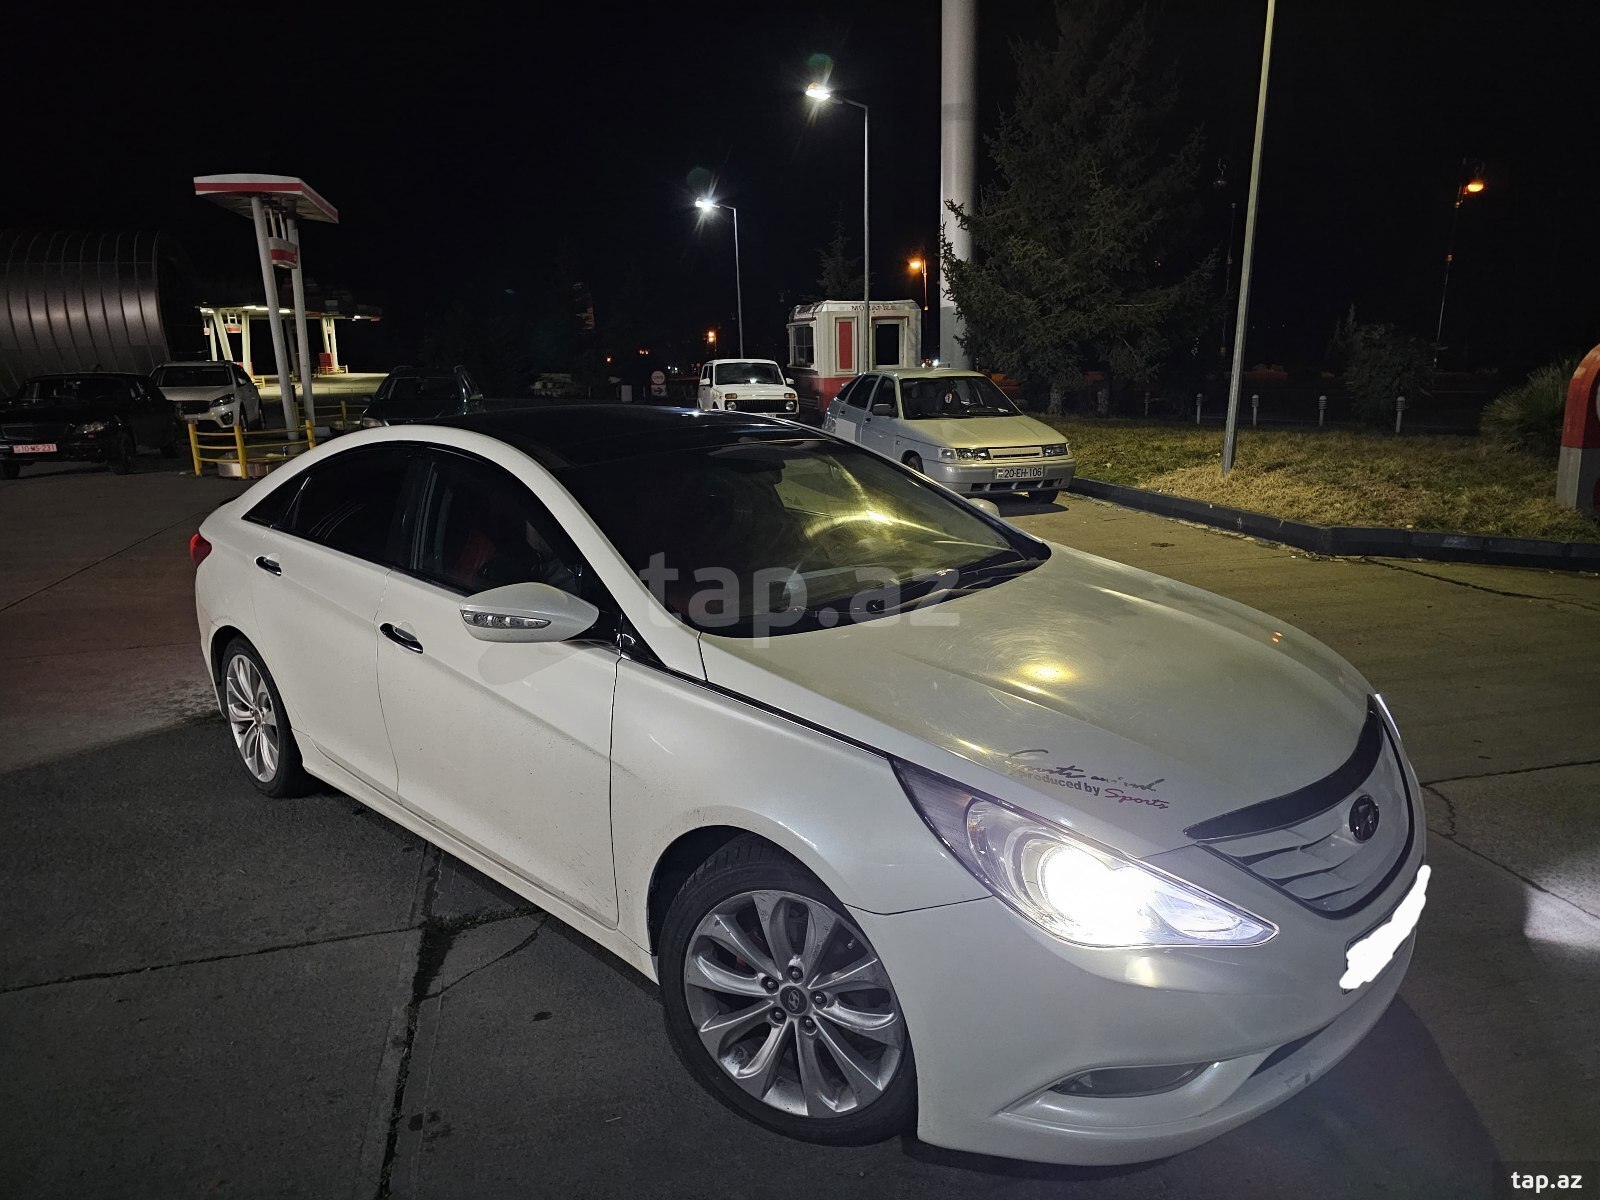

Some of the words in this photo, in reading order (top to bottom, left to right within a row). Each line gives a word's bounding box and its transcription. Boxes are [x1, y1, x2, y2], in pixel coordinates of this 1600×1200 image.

[1004, 467, 1042, 478] 20-EH-106
[1084, 782, 1101, 797] by
[1104, 788, 1170, 809] Sports
